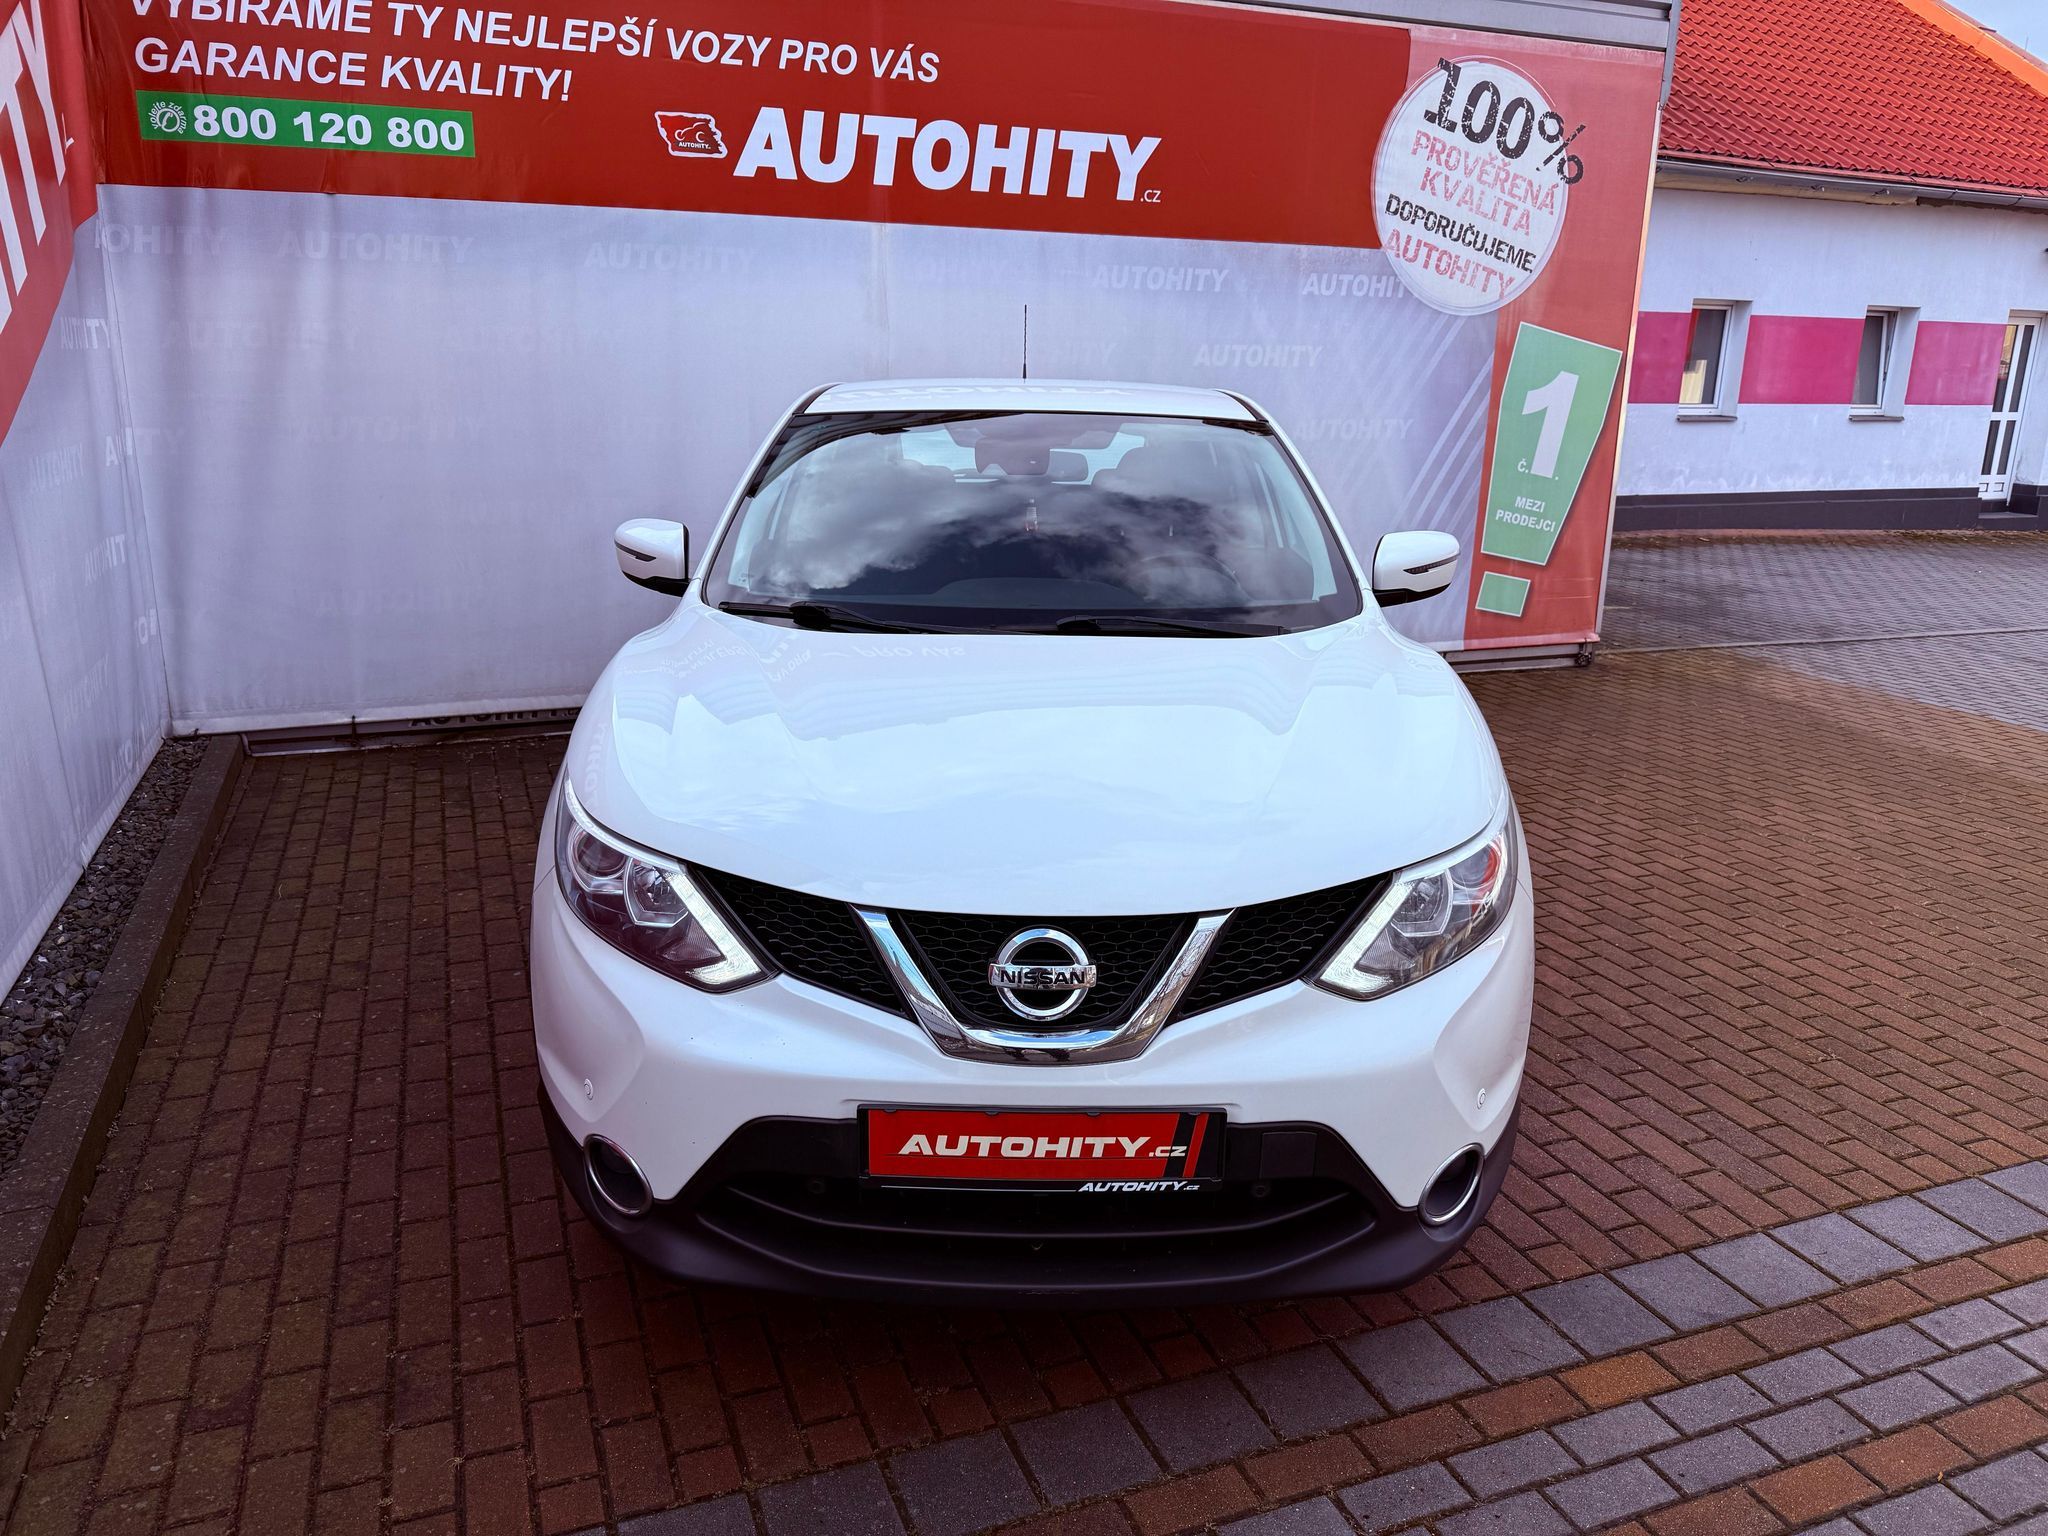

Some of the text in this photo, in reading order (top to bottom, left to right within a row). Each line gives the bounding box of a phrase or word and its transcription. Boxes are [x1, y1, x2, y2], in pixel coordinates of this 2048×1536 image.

[134, 37, 573, 102] GARANCE KVALITY!
[388, 3, 442, 38] TY
[454, 8, 657, 57] NEJLEPŠÍ
[667, 27, 772, 67] VOZY
[779, 38, 857, 76] PRO
[870, 43, 940, 83] VÁS
[168, 101, 187, 134] zdarma
[193, 104, 465, 150] 800 120 800
[1423, 57, 1587, 184] 100%
[1411, 130, 1560, 217] PROVĚŘENÁ
[1420, 166, 1532, 237] KVALITA
[1384, 194, 1537, 274] DOPORUČUJEME
[1093, 264, 1230, 293] AUTOHITY
[1384, 228, 1517, 300] AUTOHITY
[1193, 343, 1324, 368] AUTOHITY
[1495, 509, 1556, 533] PRODEJCI
[1514, 495, 1546, 513] MEZI
[1000, 970, 1085, 984] NISSAN
